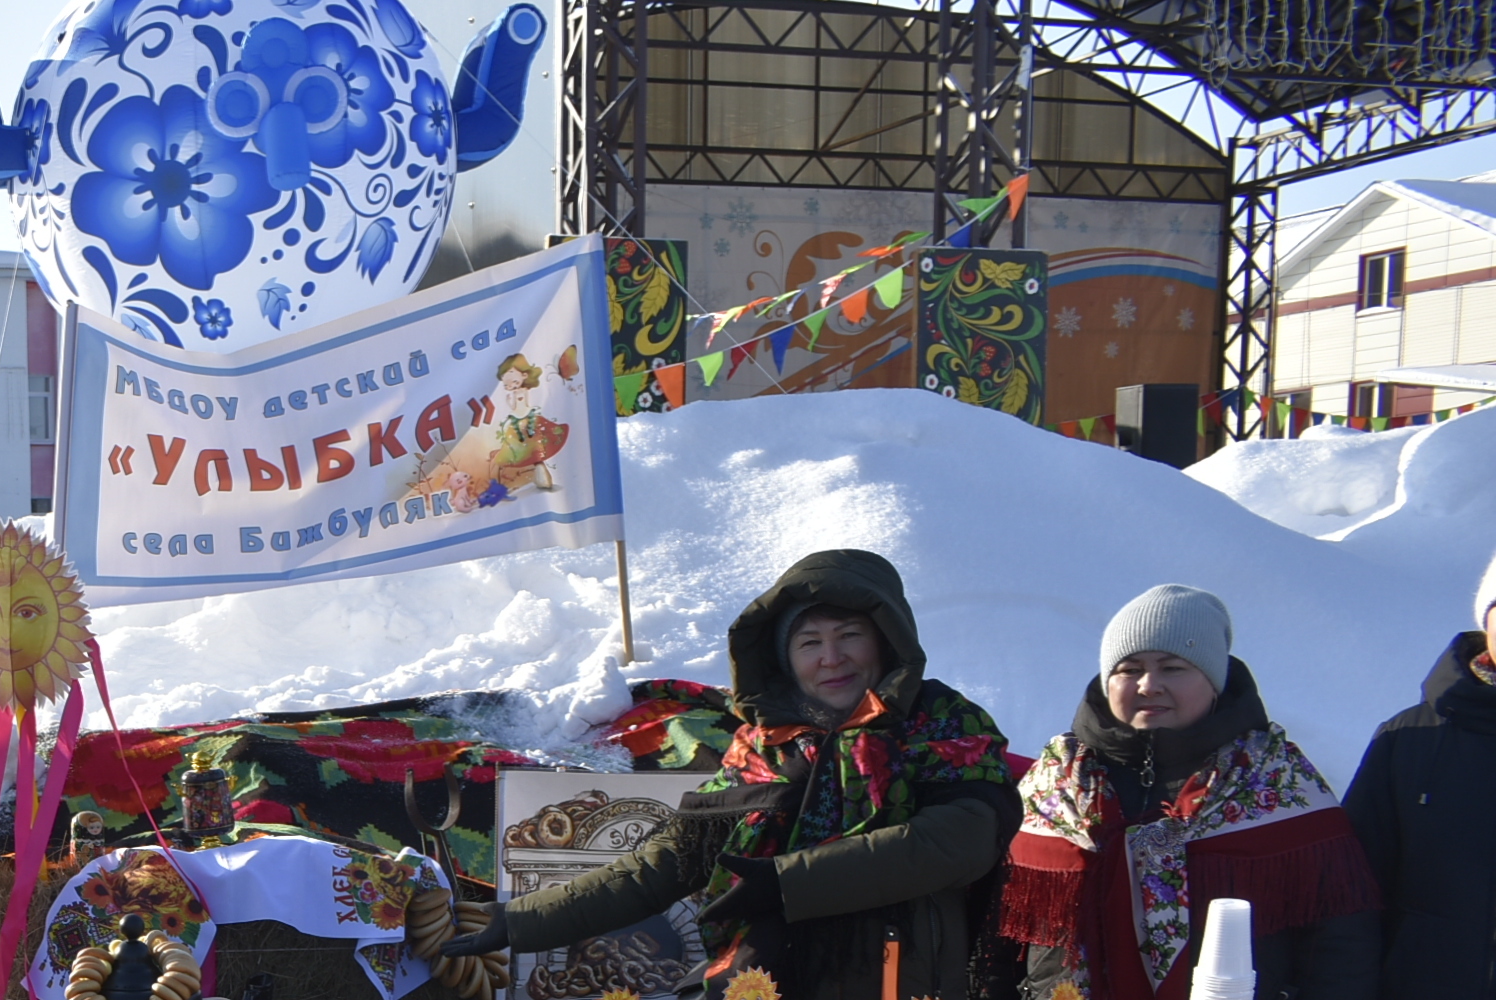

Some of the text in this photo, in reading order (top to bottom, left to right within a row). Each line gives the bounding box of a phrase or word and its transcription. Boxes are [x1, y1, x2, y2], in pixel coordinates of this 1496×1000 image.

[115, 318, 517, 421] МБДОУ детский сад
[107, 394, 496, 496] «УЛЫБКА»
[122, 490, 453, 558] села Бижбуляк
